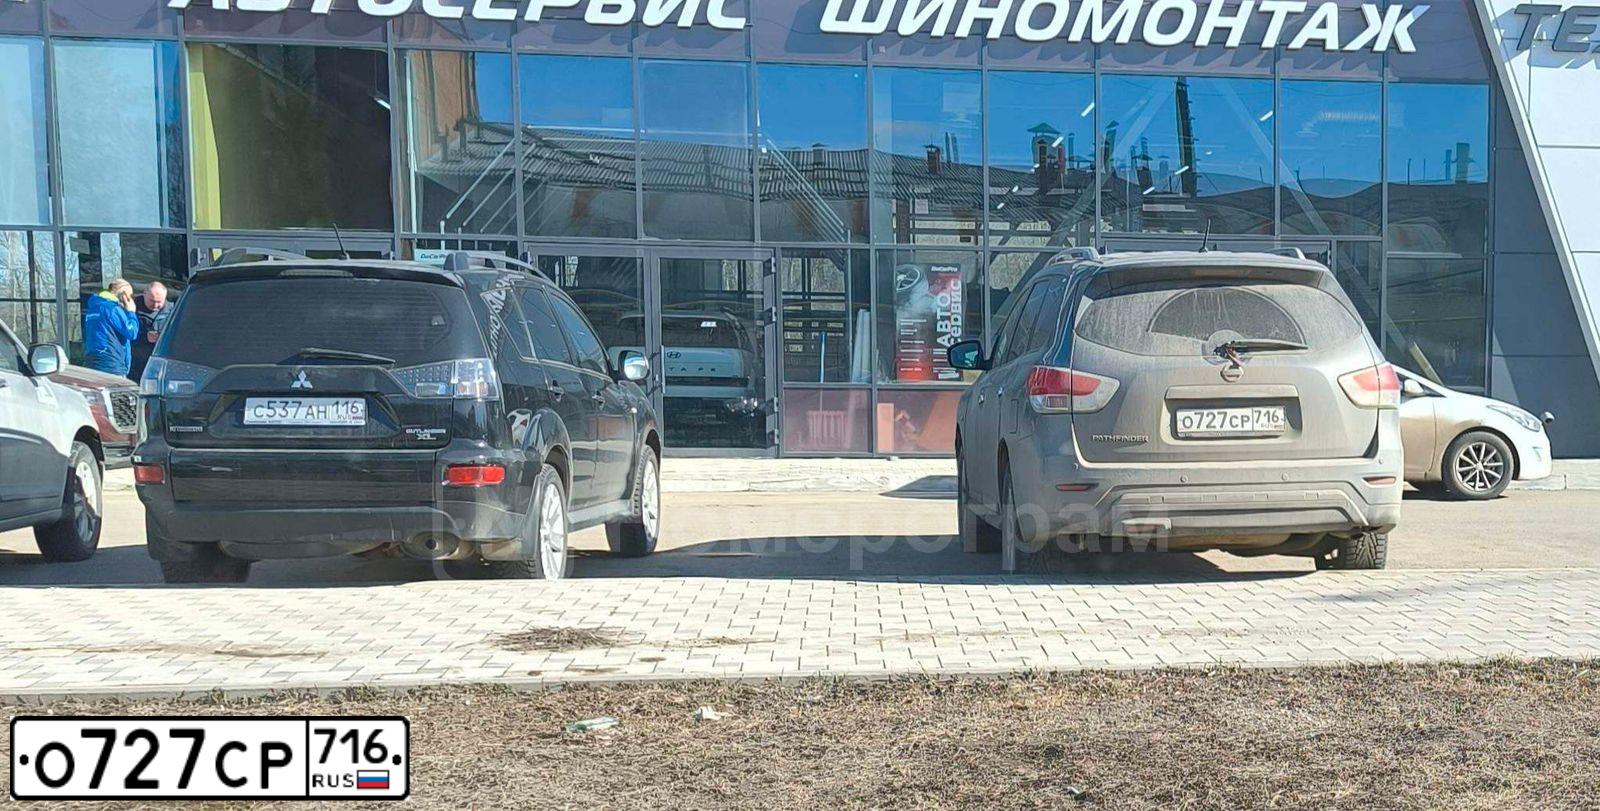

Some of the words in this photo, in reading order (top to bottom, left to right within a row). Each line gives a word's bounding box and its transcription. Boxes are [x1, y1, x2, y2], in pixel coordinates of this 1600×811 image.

[819, 0, 1431, 53] ШИНОМОНТАЖ
[1514, 3, 1600, 53] ТЕ
[936, 292, 951, 347] АВТО
[331, 400, 359, 415] 116
[1182, 411, 1251, 429] О727СР
[1254, 409, 1280, 424] 716
[1092, 434, 1149, 443] PATHFINDER
